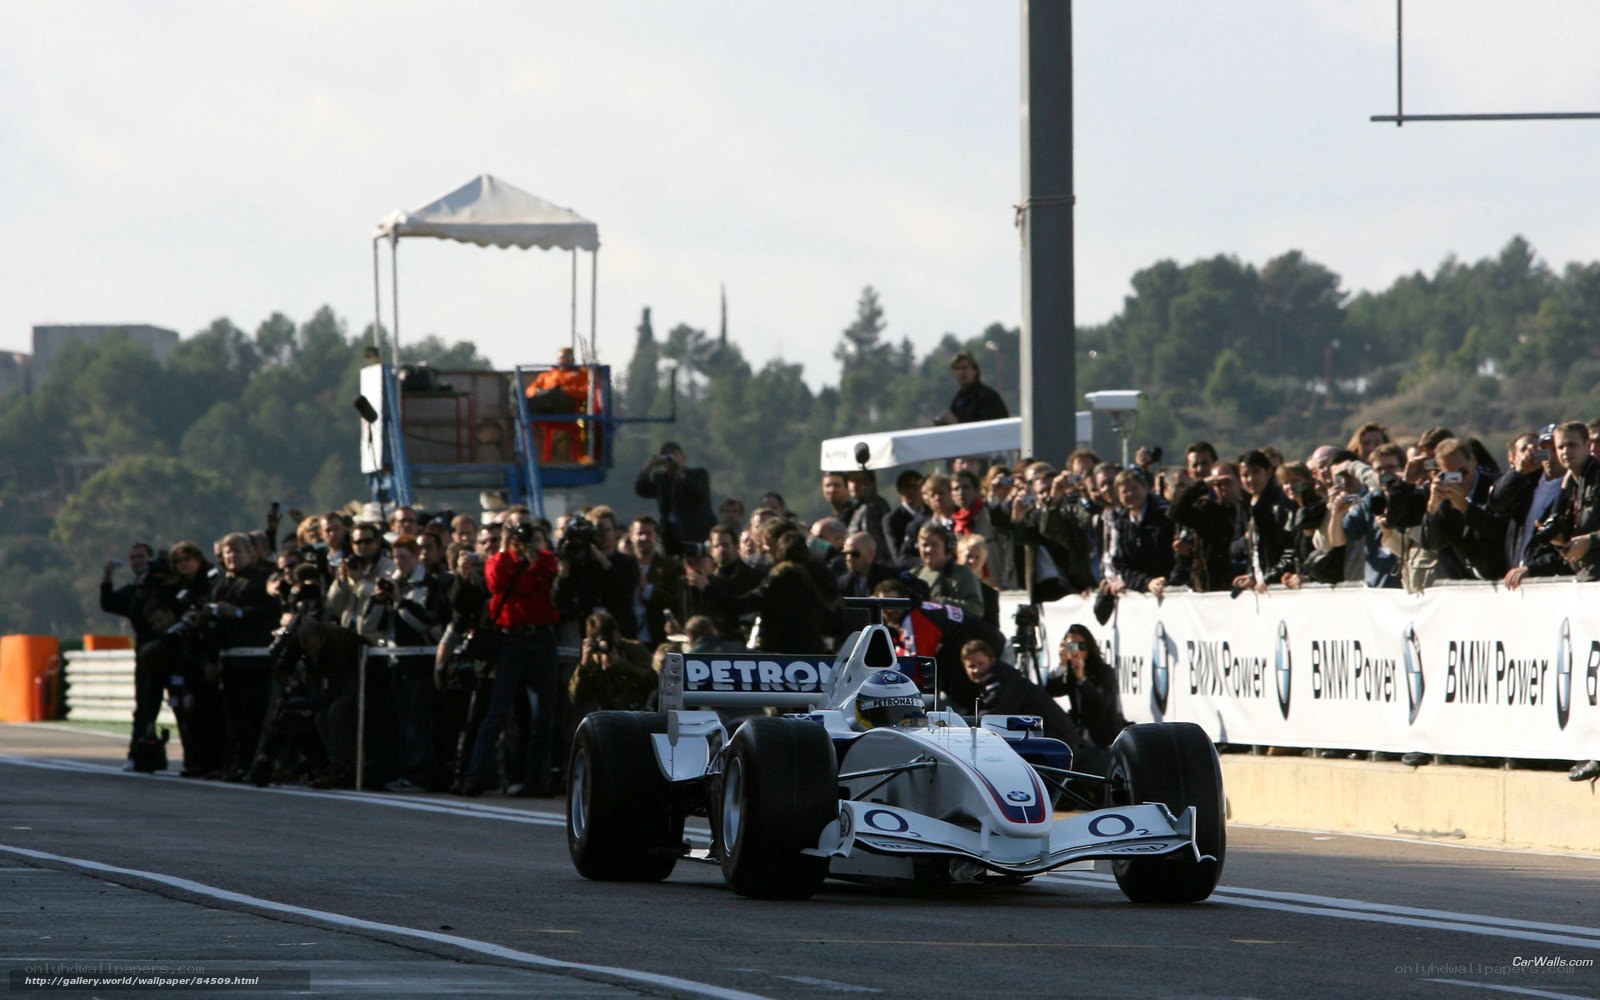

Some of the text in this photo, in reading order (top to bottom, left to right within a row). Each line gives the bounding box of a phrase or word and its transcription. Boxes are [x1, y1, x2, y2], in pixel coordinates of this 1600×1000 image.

[1222, 640, 1267, 699] Power
[1312, 640, 1397, 702] BMW Power
[1445, 640, 1549, 706] BMW Power
[873, 697, 915, 708] PETRONAS
